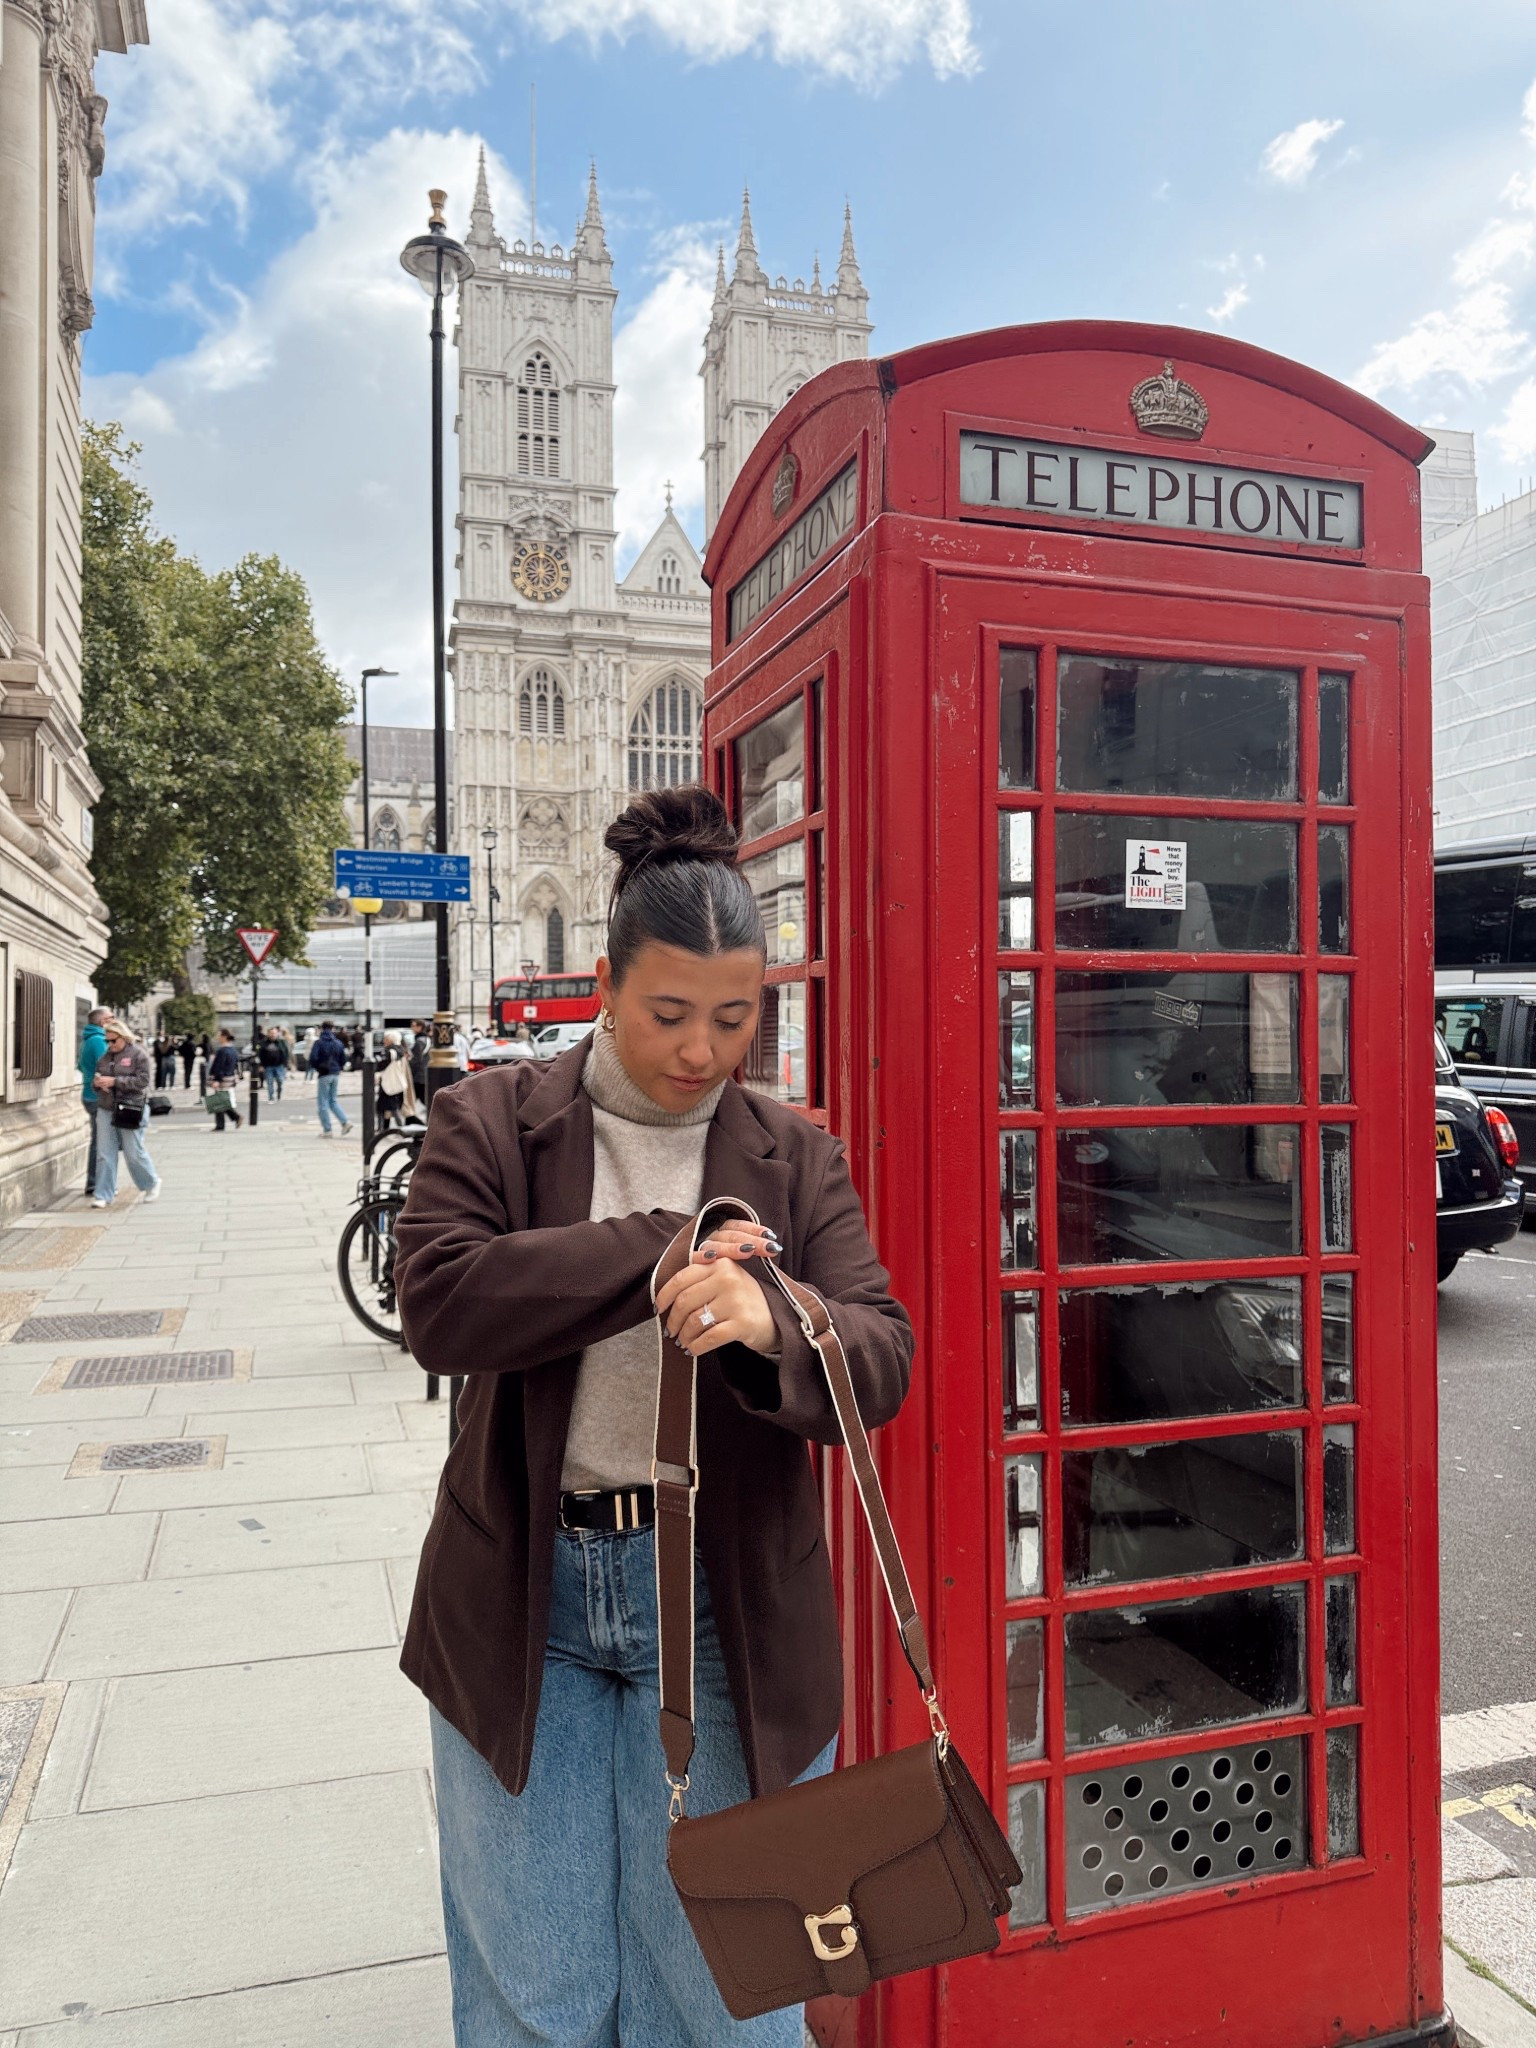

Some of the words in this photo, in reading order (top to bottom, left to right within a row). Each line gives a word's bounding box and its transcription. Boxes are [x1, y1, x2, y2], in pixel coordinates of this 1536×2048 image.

[972, 443, 1345, 544] TELEPHONE
[735, 467, 857, 632] TELEPHONE
[355, 855, 398, 863] Westminster
[400, 857, 423, 865] Bridge
[410, 880, 432, 889] Bridge
[1130, 876, 1150, 886] The
[411, 889, 434, 897] Bridge
[1130, 887, 1163, 897] LIGHT
[1154, 996, 1181, 1018] 1899
[1436, 1130, 1448, 1146] M
